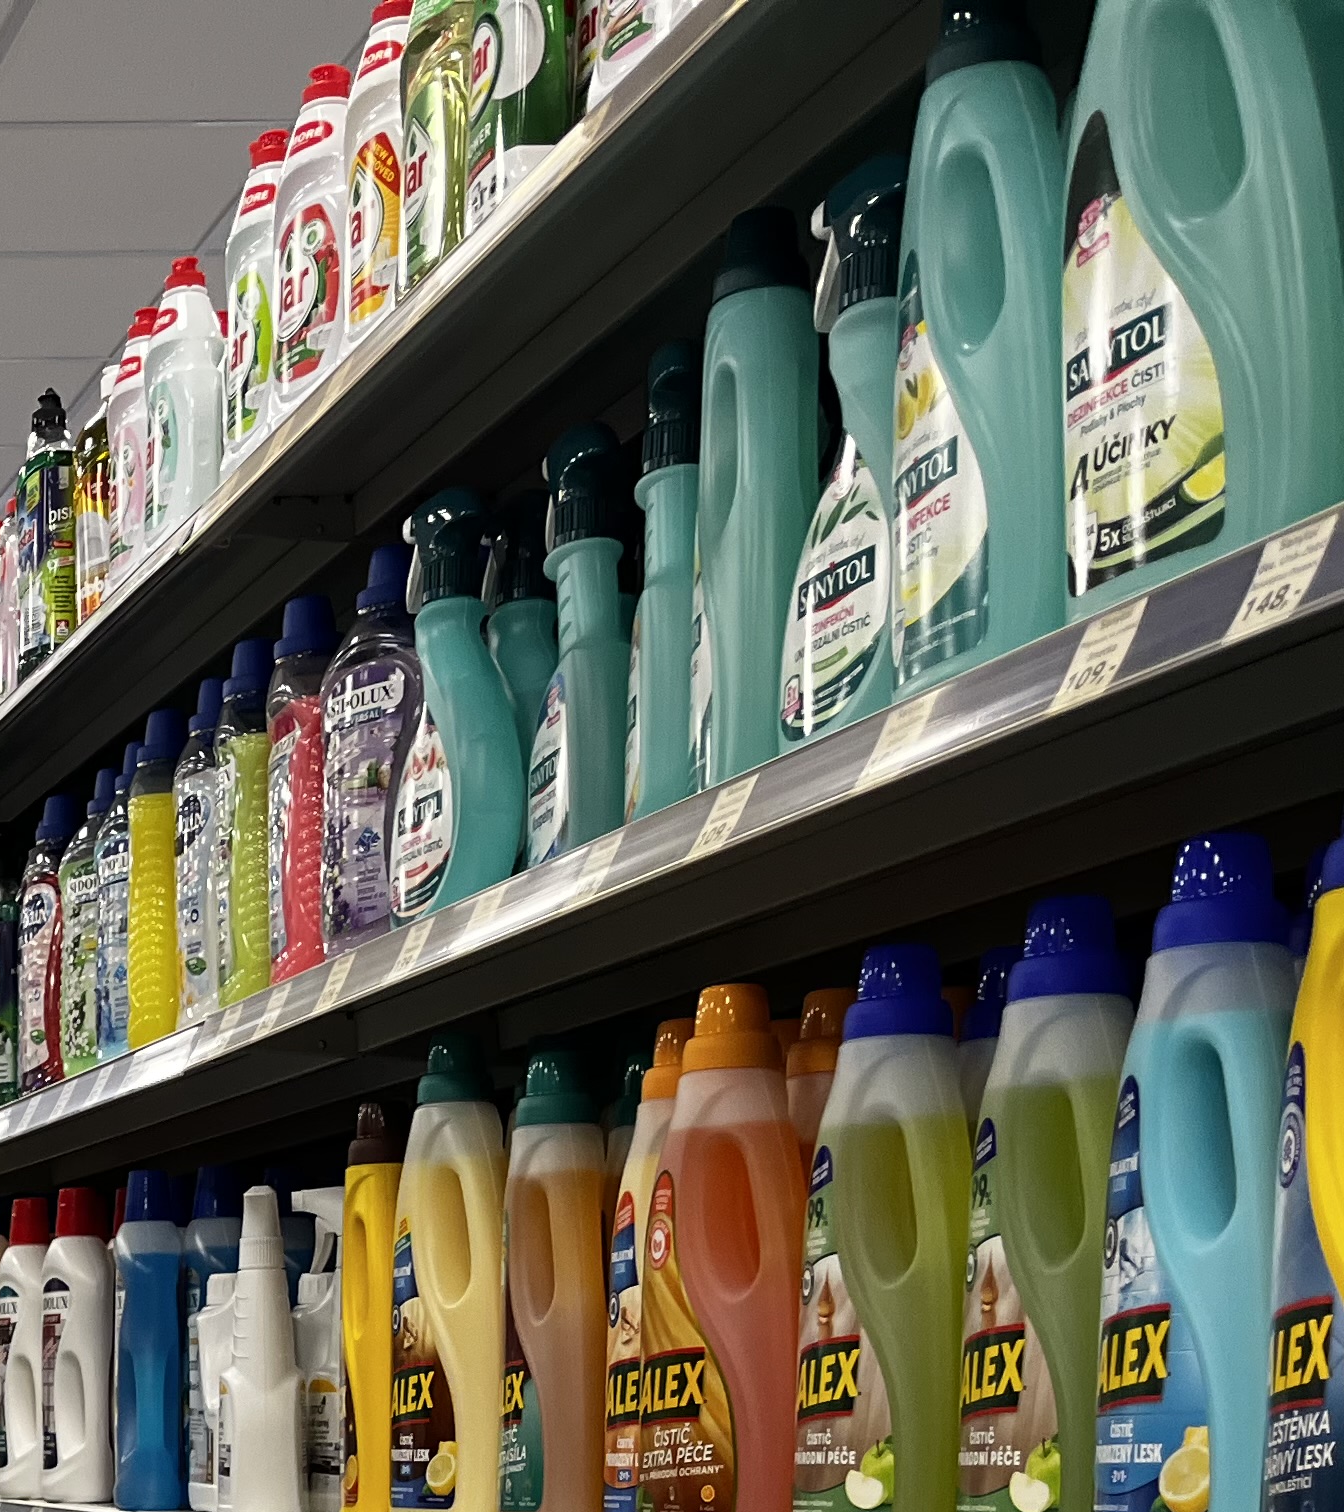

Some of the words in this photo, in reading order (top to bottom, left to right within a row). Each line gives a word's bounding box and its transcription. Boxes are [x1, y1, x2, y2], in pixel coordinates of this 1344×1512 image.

[1067, 378, 1128, 428] DEZINFEKCE
[1070, 453, 1089, 501] 4
[1099, 526, 1121, 553] 5x
[1241, 583, 1303, 623] 148,-
[1066, 660, 1116, 692] 109,-
[1099, 1319, 1171, 1395] ALEX
[640, 1358, 708, 1416] ALEX
[796, 1349, 861, 1410] ALEX
[960, 1339, 1025, 1410] ALEX
[390, 1369, 435, 1420] ALEX
[653, 1421, 691, 1448] ČISTIČ
[806, 1429, 833, 1446] ČISTIČ
[969, 1426, 995, 1445] ČISTIČ
[1110, 1420, 1134, 1438] ČISTIČ
[642, 1451, 675, 1470] EXTRA
[675, 1442, 714, 1466] PÉČE
[827, 1445, 857, 1466] PÉČE
[989, 1445, 1021, 1467] PÉČE
[1133, 1442, 1163, 1464] LESK
[1296, 1441, 1336, 1472] LESK
